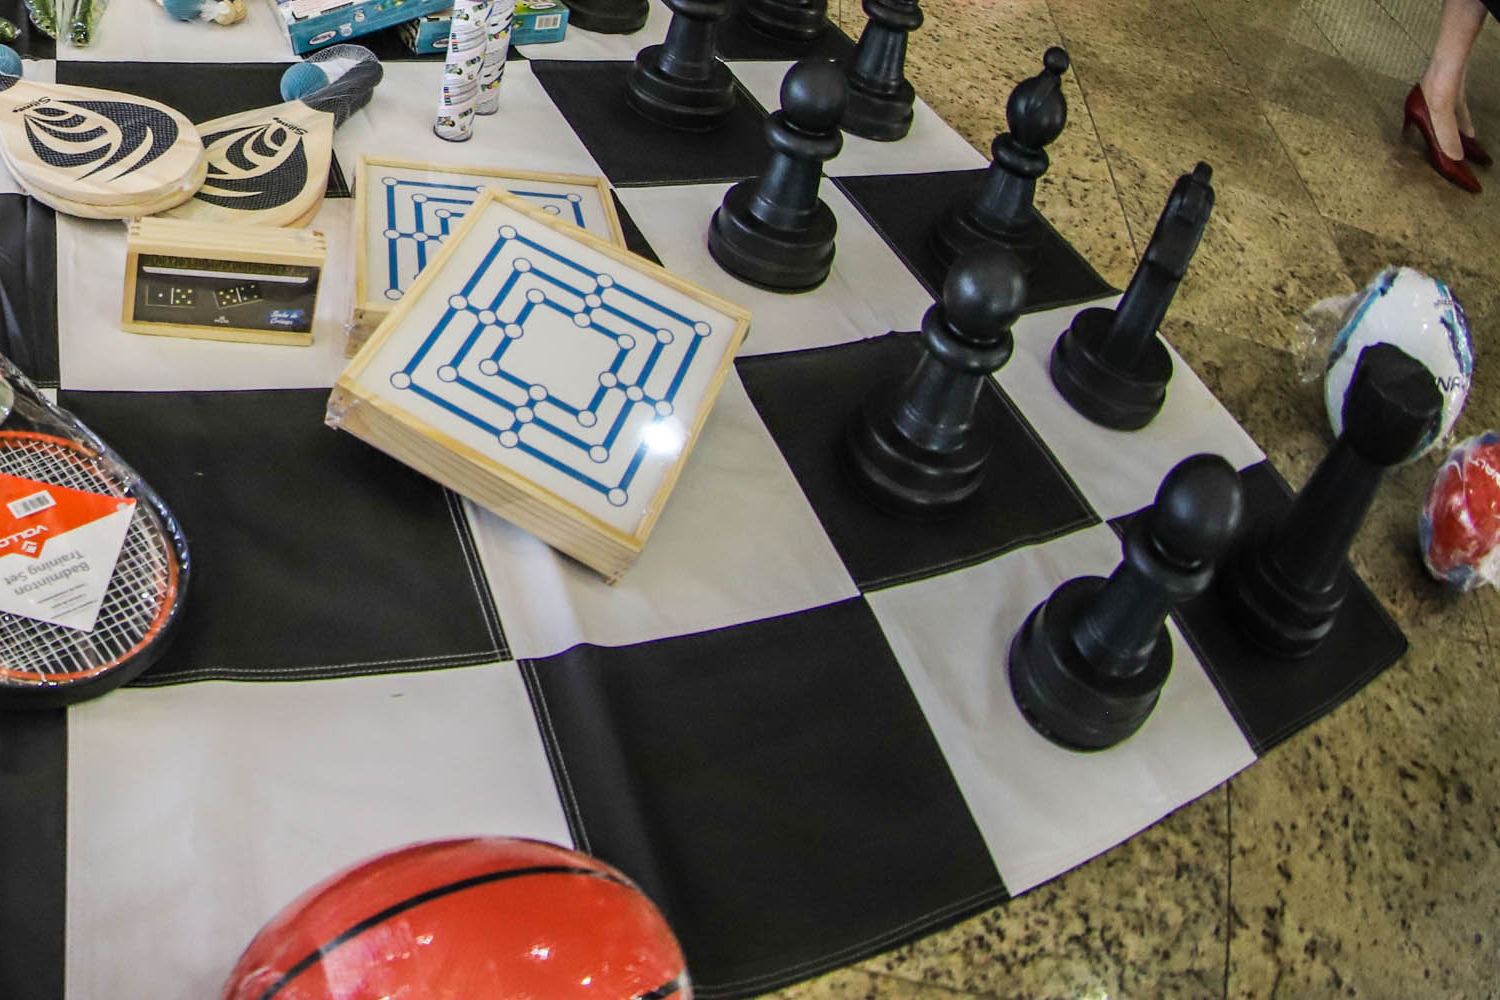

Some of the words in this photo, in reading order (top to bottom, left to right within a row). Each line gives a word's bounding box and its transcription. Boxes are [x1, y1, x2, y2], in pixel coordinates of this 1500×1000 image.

[26, 549, 84, 577] Training
[4, 571, 30, 587] Set
[13, 561, 91, 596] Badminton
